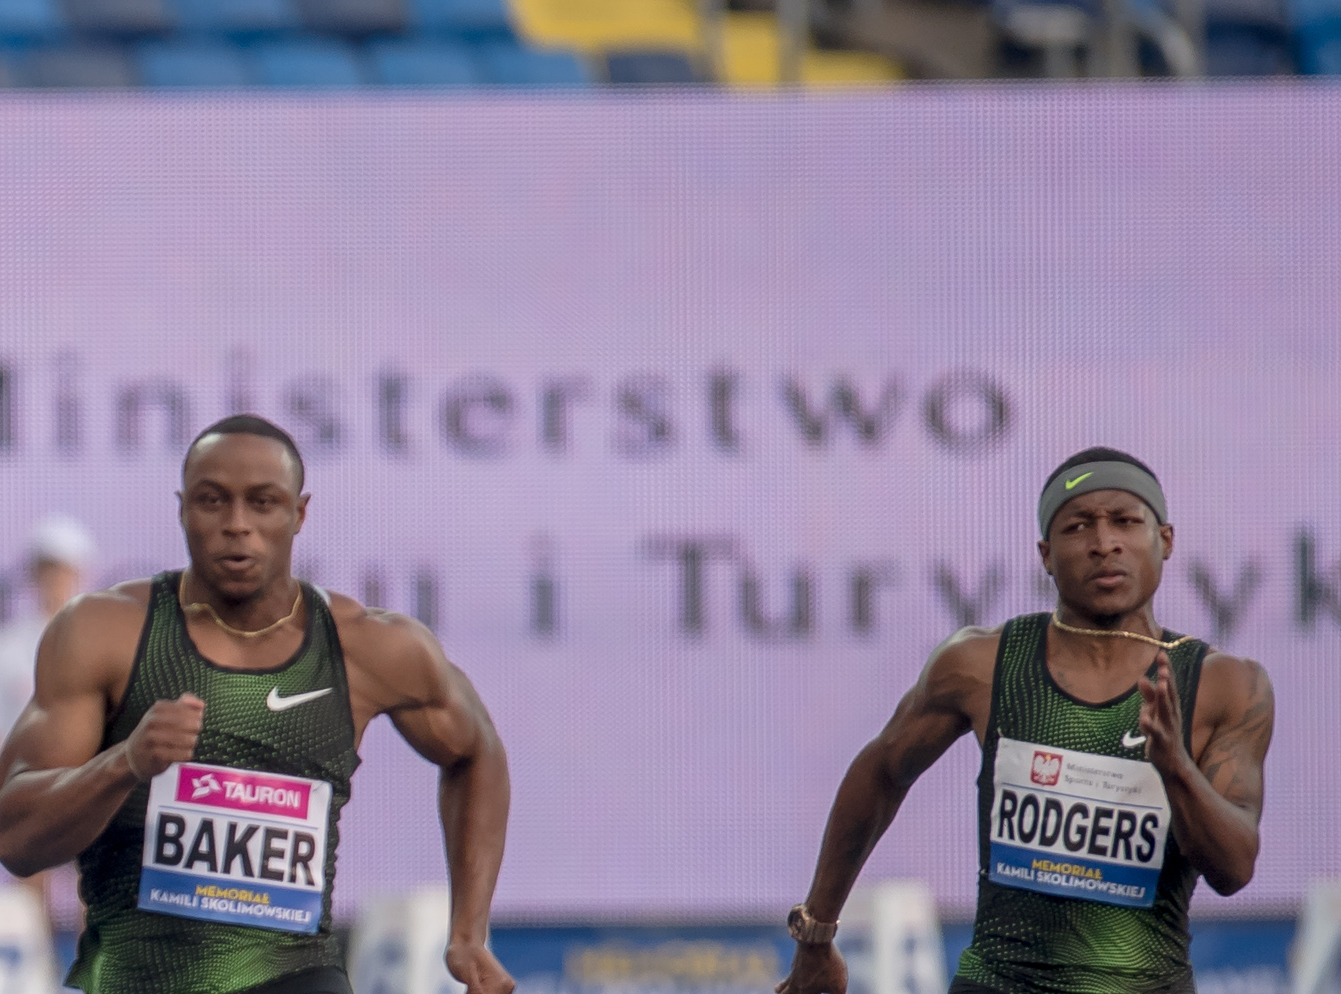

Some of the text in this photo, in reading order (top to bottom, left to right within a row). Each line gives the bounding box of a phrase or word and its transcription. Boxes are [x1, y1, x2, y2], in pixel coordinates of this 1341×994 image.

[636, 530, 1341, 645] Turyyk
[222, 781, 302, 809] TAURON
[997, 788, 1160, 863] RODGERS
[154, 812, 316, 886] BAKER
[996, 862, 1147, 899] KAMILI SKOLIMOWSKIEJ
[1031, 858, 1103, 879] MEMORIAŁ
[150, 888, 312, 923] KAMILI SKOLIMOWSKIEJ
[195, 884, 272, 904] MEMORIAŁ
